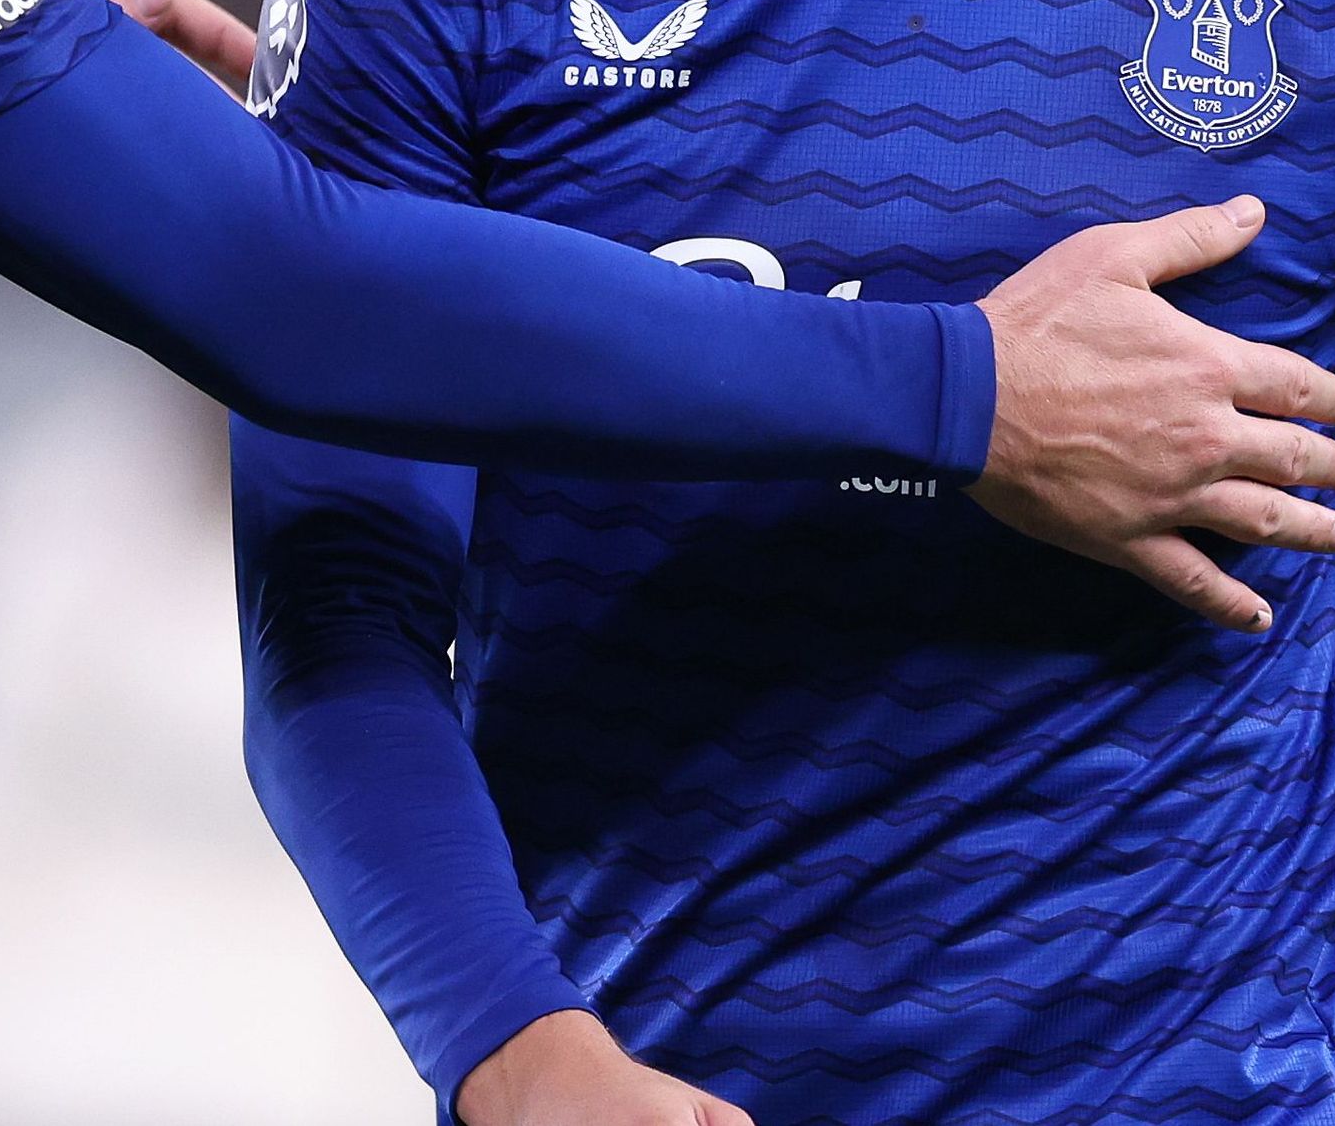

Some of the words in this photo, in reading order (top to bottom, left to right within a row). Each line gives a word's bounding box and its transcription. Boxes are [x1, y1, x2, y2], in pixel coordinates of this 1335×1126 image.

[564, 65, 692, 89] CASTORE
[1162, 67, 1255, 98] Everton
[1129, 85, 1147, 110] NIL
[1148, 108, 1186, 136] SATIS
[1190, 130, 1223, 143] NISI
[1228, 98, 1286, 141] OPTIMUM
[1192, 98, 1222, 113] 1878
